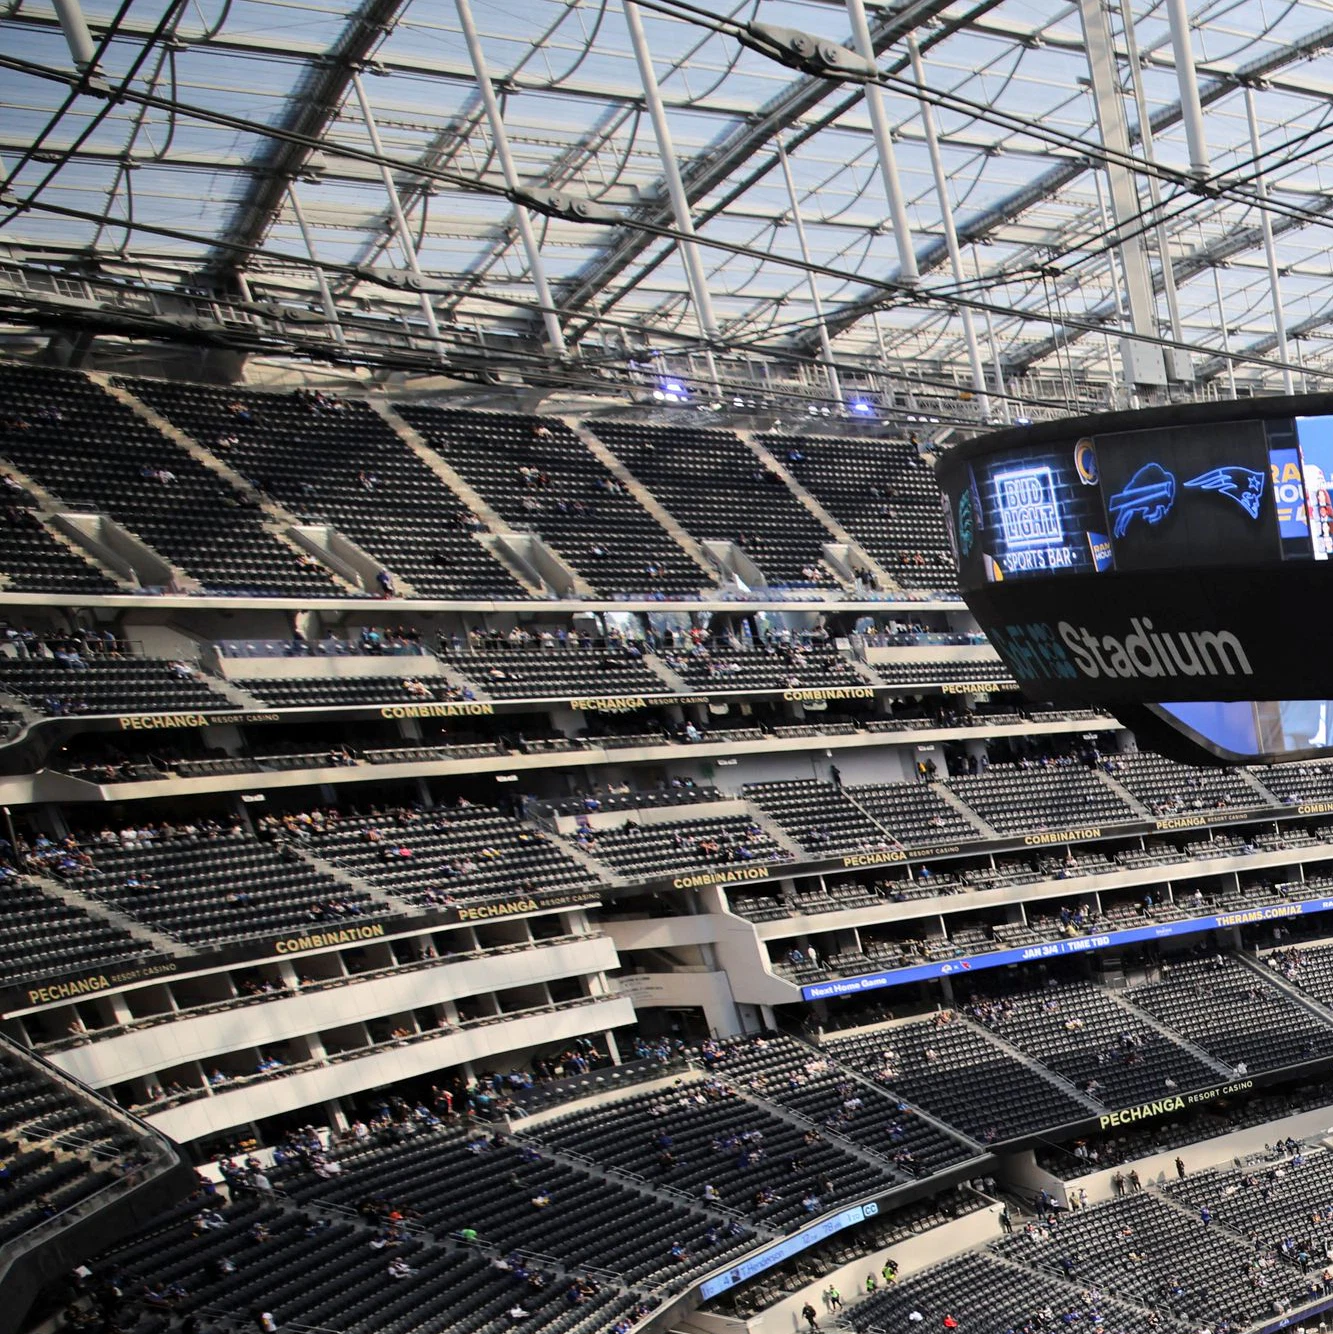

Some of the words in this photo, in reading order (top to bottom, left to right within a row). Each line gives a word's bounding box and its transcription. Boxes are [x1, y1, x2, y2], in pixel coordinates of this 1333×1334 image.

[1004, 476, 1044, 507] BUD
[1004, 505, 1058, 537] LIGHT
[1006, 549, 1046, 572] SPORTS
[1047, 547, 1072, 566] BAR
[1058, 616, 1254, 679] Stadium
[783, 688, 874, 701] COMBINATION
[942, 683, 1000, 694] PECHANGA
[380, 704, 494, 719] COMBINATION
[570, 697, 648, 710] PECHANGA
[120, 714, 210, 730] PECHANGA
[1156, 816, 1207, 830] PECHANGA
[1024, 828, 1101, 845] COMBINATION
[843, 850, 908, 867] PECHANGA
[673, 868, 770, 889] COMBINATION
[458, 898, 540, 920] PECHANGA
[1215, 904, 1303, 927] THERAMS.COM/AZ
[275, 923, 384, 954] COMBINATION
[1021, 946, 1041, 959] JAN
[1042, 944, 1059, 957] 3/4
[1066, 940, 1089, 954] TIME
[1090, 936, 1110, 951] TBD
[28, 974, 111, 1004] PECHANGA
[810, 986, 833, 997] Next
[836, 981, 860, 994] Home
[861, 978, 888, 990] Game
[1099, 1096, 1186, 1130] PECHANGA
[1188, 1088, 1220, 1104] RESORT
[1222, 1080, 1254, 1096] CASINO
[865, 1204, 877, 1216] CC
